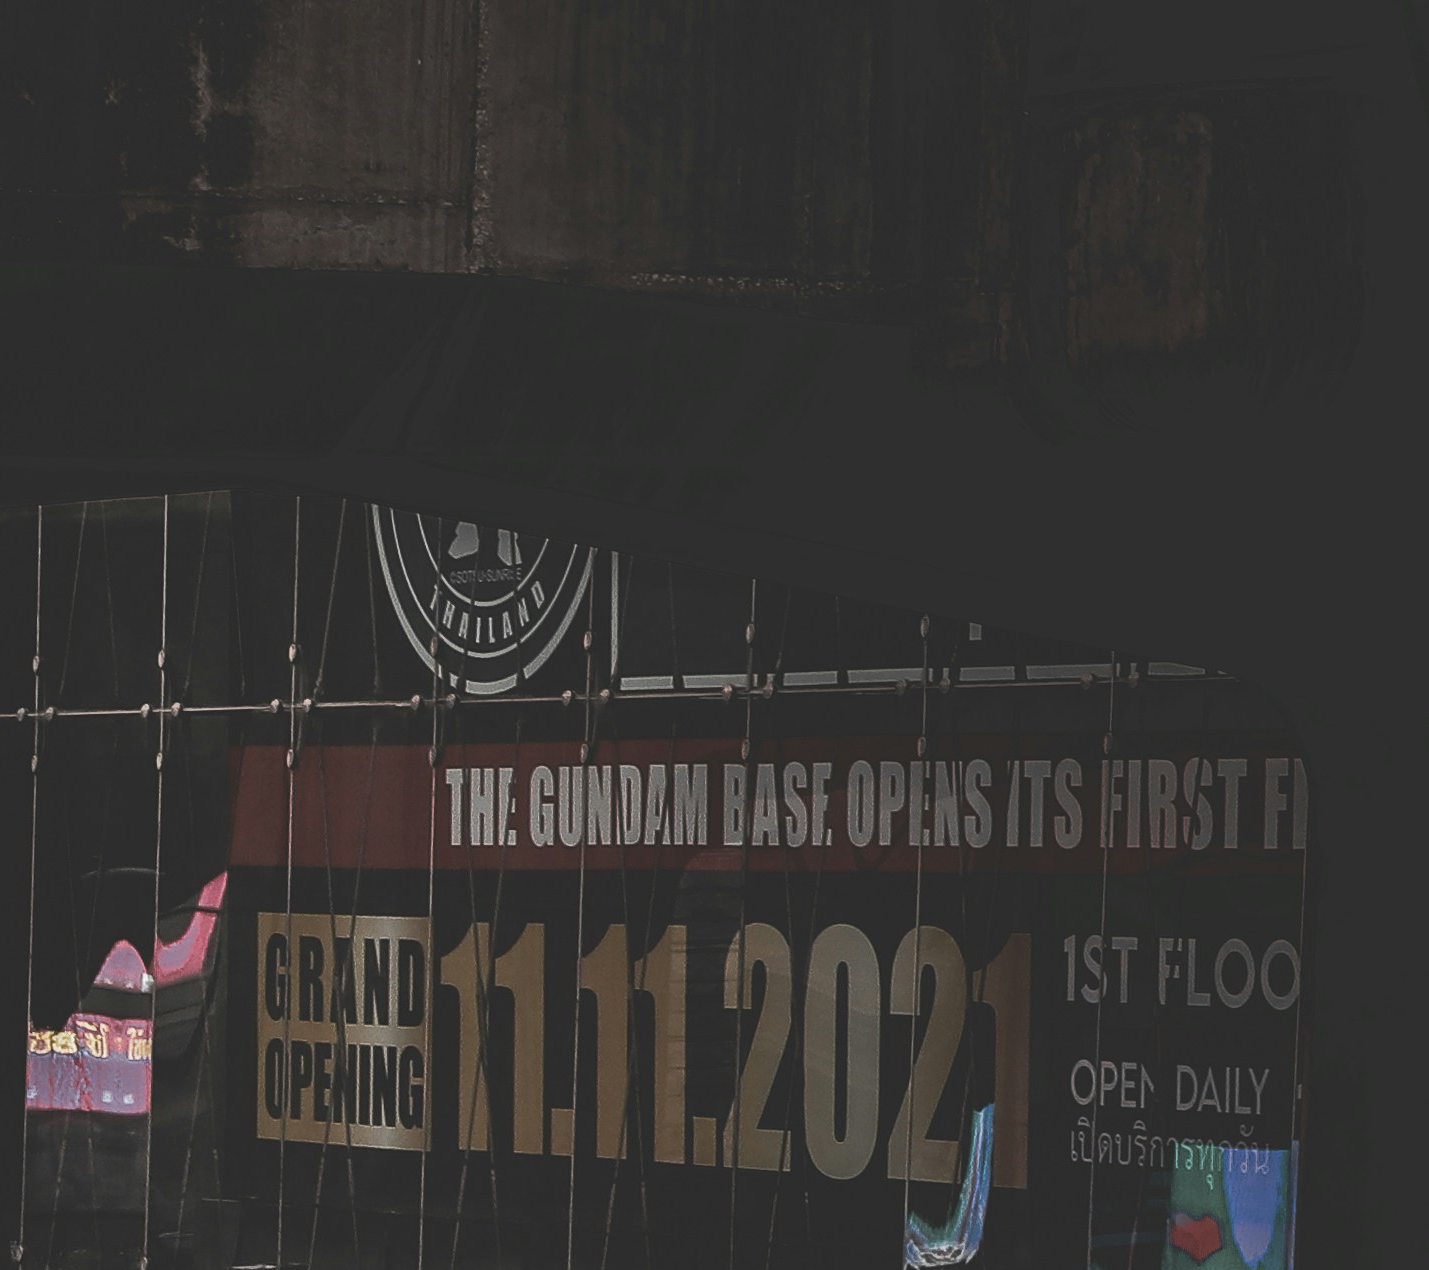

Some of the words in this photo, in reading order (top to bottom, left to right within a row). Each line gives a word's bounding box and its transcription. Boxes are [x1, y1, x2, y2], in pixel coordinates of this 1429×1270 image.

[429, 581, 545, 643] THAILAND
[446, 767, 517, 847] THE
[530, 764, 708, 847] GUNDAM
[723, 761, 833, 847] BASE
[847, 759, 992, 848] OPENS
[1006, 758, 1083, 849] ITS
[1100, 757, 1248, 851] FIRST
[265, 933, 424, 1028] GRAND
[1064, 934, 1138, 1004] 1ST
[265, 1038, 425, 1130] OPENING
[439, 921, 1032, 1189] 11.11.2021
[1071, 1059, 1156, 1108] OPEN
[1175, 1064, 1270, 1115] DAILY
[1070, 1116, 1270, 1190] เปิดบริการทุกวัน
